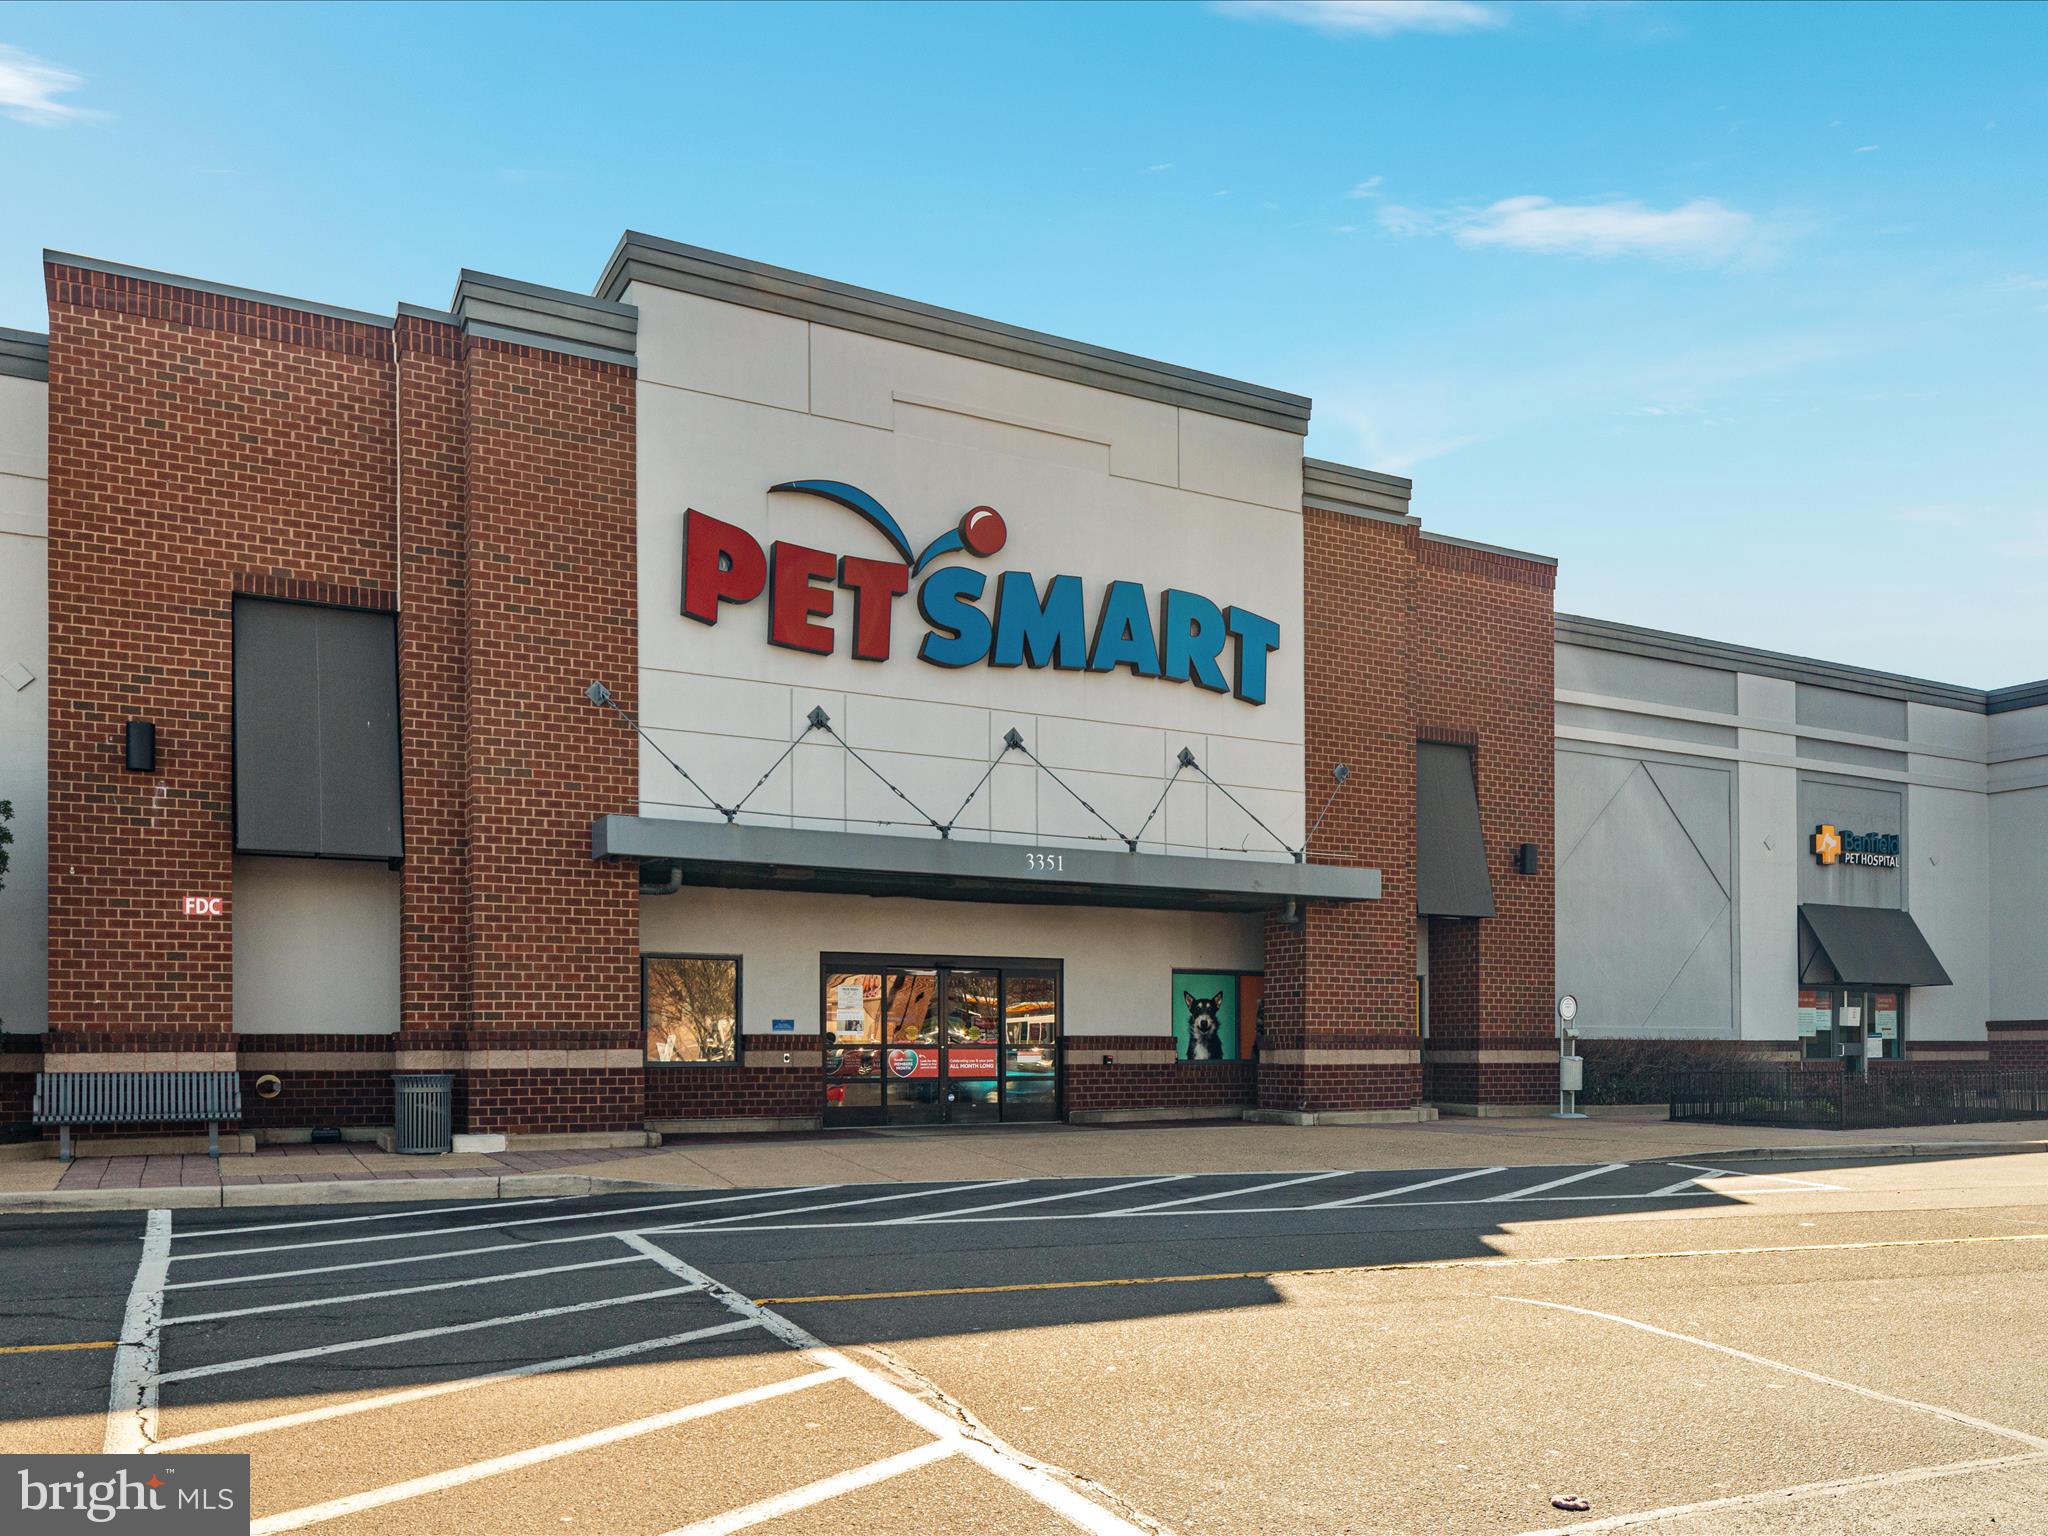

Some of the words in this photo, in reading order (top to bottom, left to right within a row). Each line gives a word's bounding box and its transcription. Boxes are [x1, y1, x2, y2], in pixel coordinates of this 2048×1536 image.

[1841, 830, 1899, 854] Banfield
[1026, 853, 1063, 871] 3351
[1845, 852, 1859, 864] PET
[1861, 854, 1900, 867] HOSPITAL
[185, 897, 220, 915] FDC
